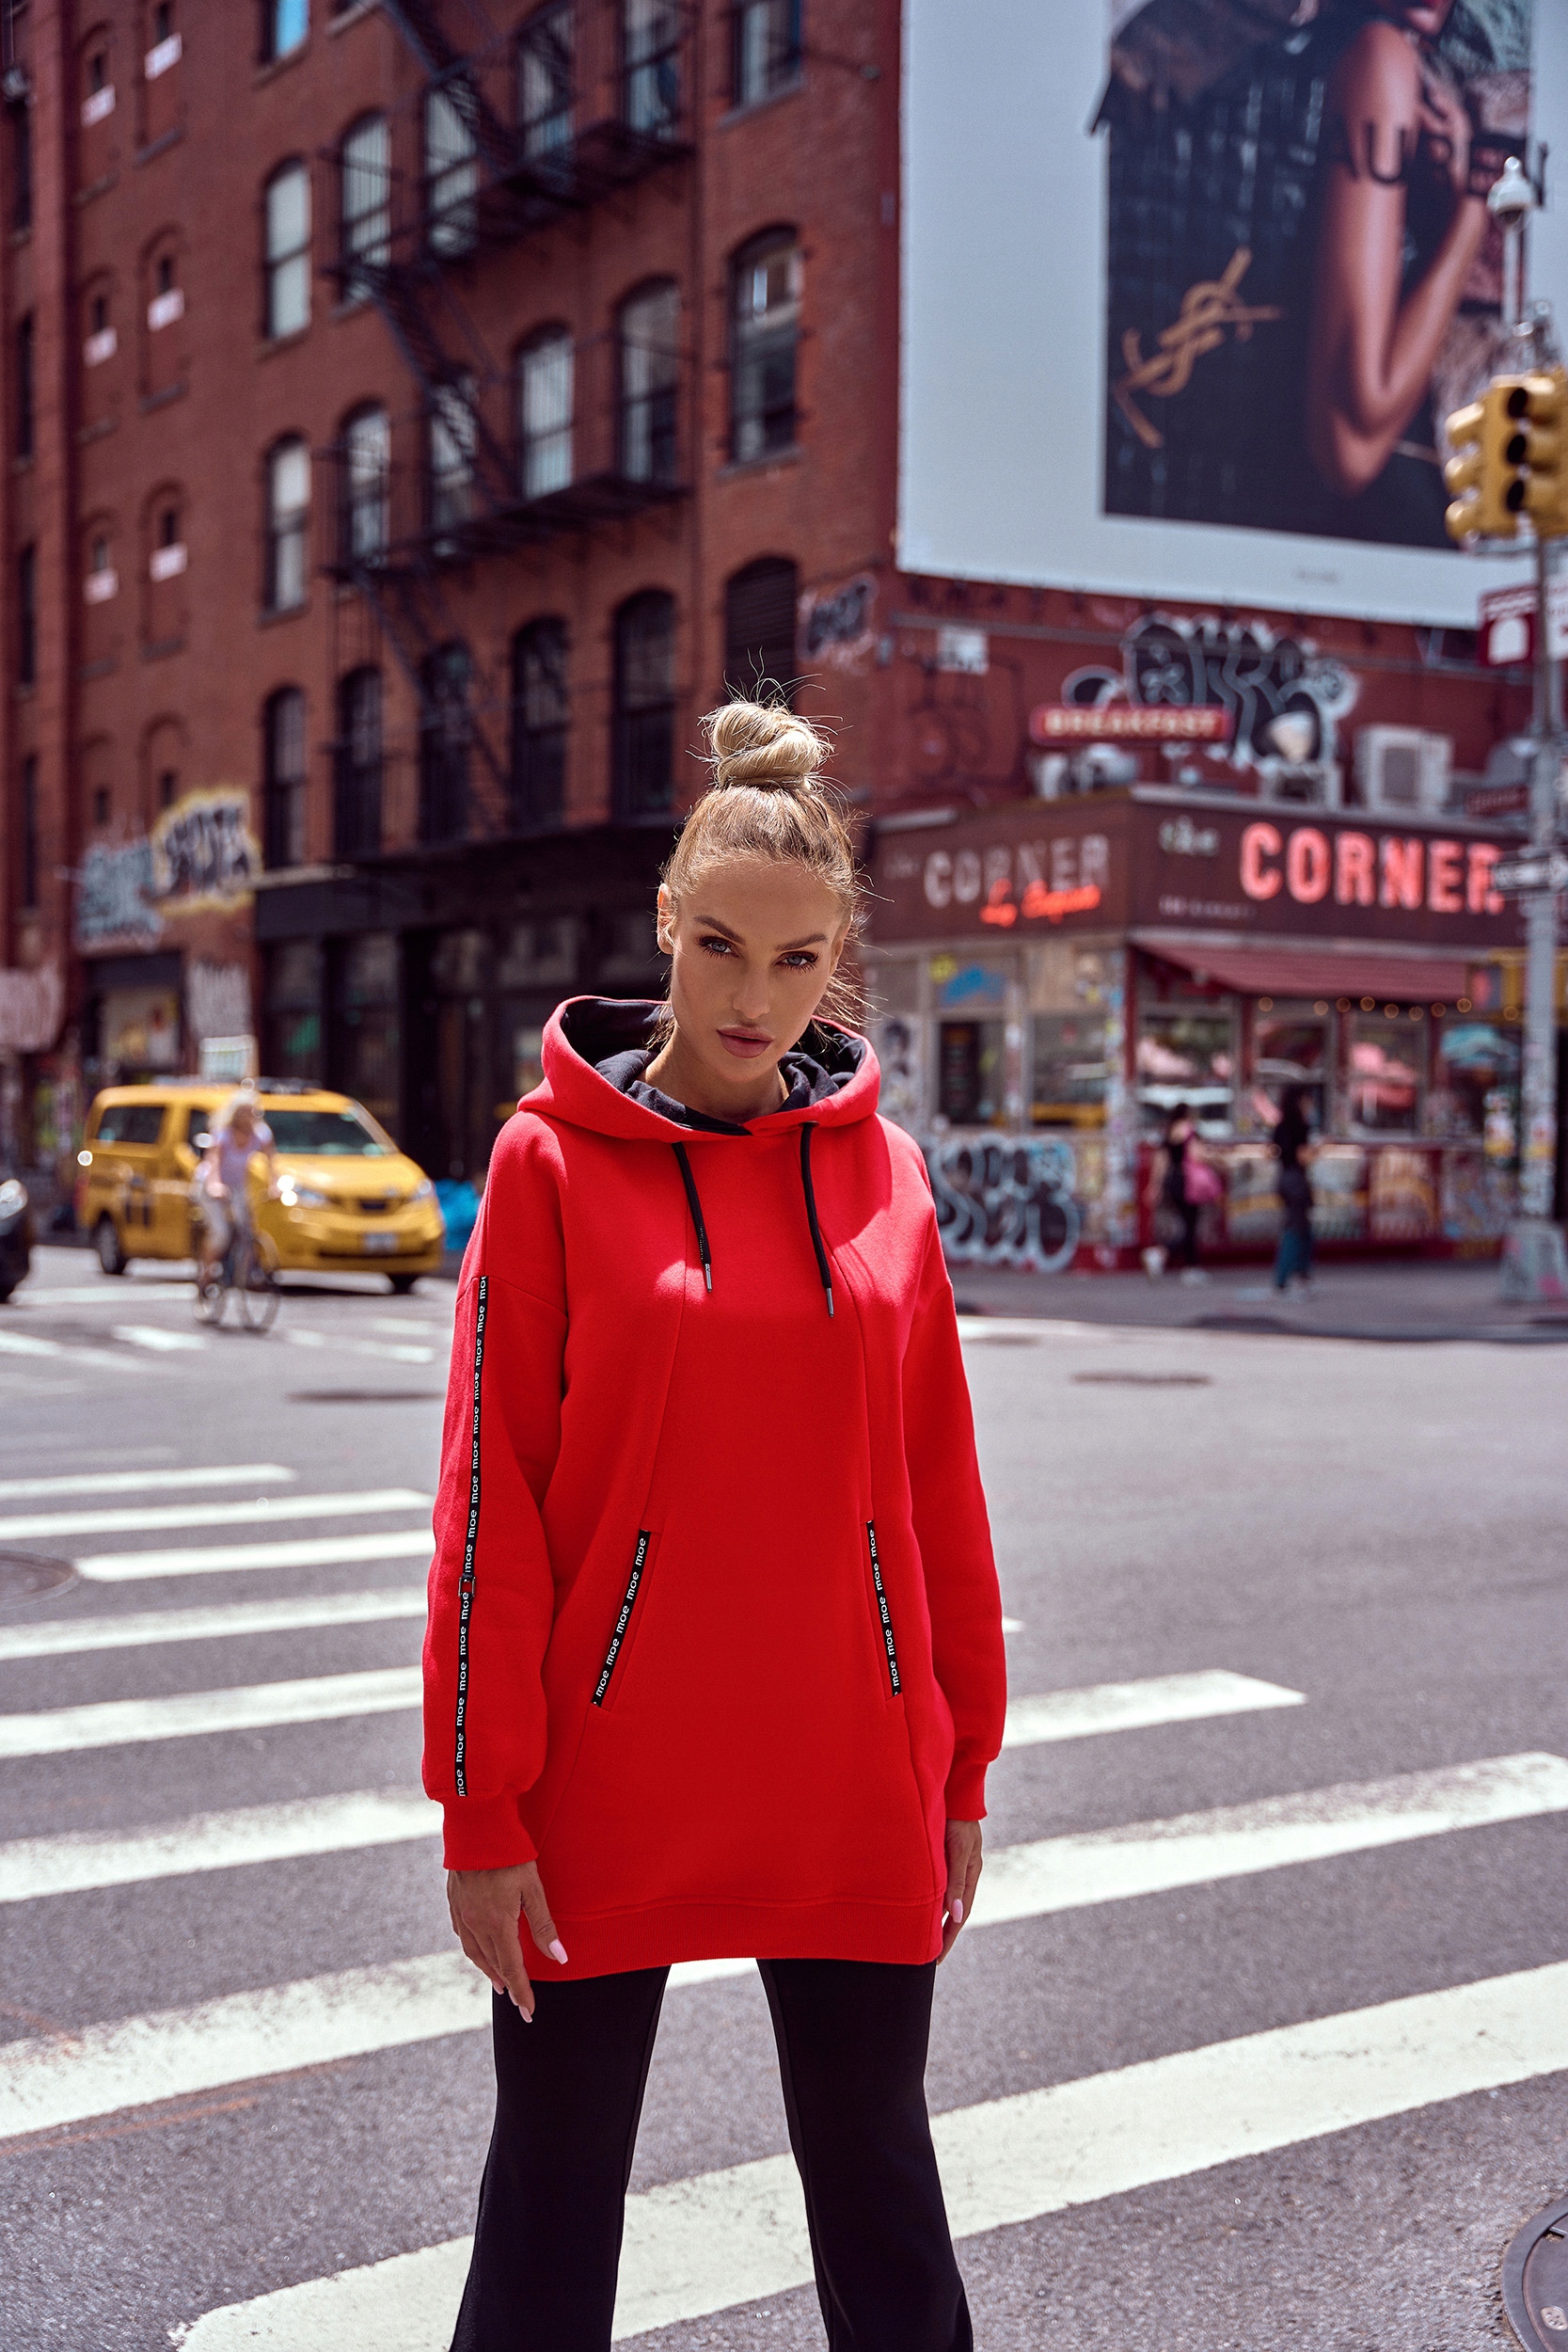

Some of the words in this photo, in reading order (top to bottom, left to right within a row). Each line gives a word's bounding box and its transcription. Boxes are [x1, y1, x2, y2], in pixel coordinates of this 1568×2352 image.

[1044, 708, 1217, 738] BREAKFAST
[924, 834, 1110, 909] CORNER
[1240, 821, 1505, 915] CORNER
[476, 1305, 485, 1333] moe
[470, 1475, 479, 1504] moe
[467, 1509, 478, 1538] moe
[869, 1529, 878, 1558] moe
[465, 1544, 473, 1573] moe
[873, 1563, 883, 1591] moe
[461, 1591, 469, 1620] moe
[595, 1670, 610, 1697] moe
[606, 1638, 620, 1666] moe
[615, 1605, 630, 1634] moe
[626, 1571, 640, 1600] moe
[634, 1537, 646, 1566] moe
[879, 1596, 891, 1624] moe
[885, 1629, 895, 1656] moe
[459, 1661, 467, 1692] moe
[889, 1661, 900, 1687] moe
[456, 1696, 465, 1726] moe
[455, 1732, 465, 1763] moe
[456, 1769, 467, 1797] moe
